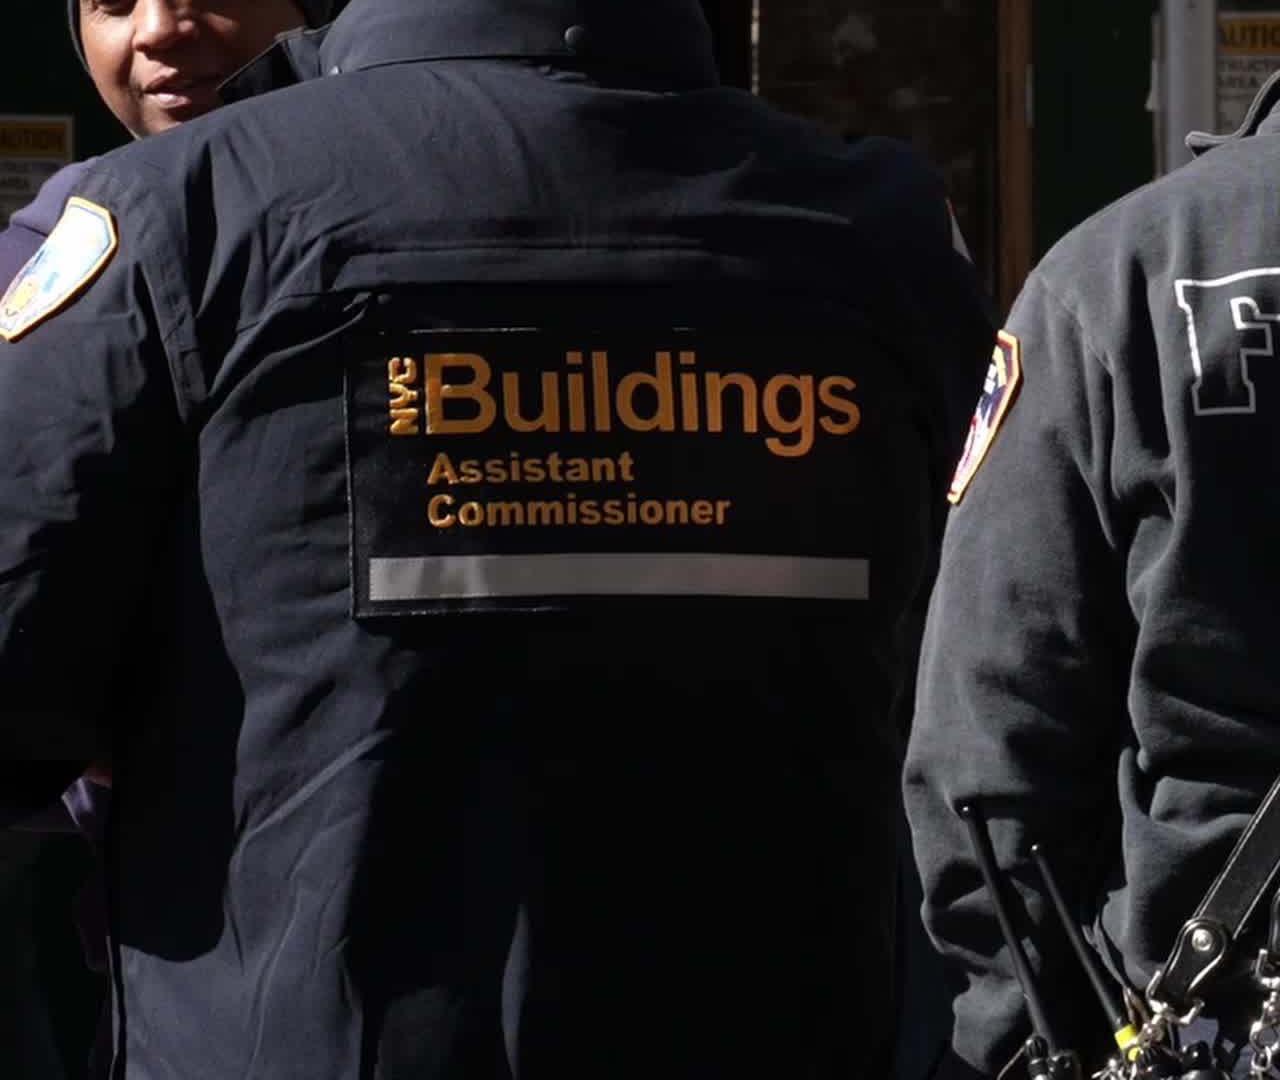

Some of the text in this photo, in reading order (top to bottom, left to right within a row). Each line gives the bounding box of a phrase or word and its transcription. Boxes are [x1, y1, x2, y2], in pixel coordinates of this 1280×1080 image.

[385, 356, 420, 436] NYC
[424, 350, 862, 458] Buildings
[425, 450, 636, 486] Assistant
[426, 491, 733, 530] Commissioner
